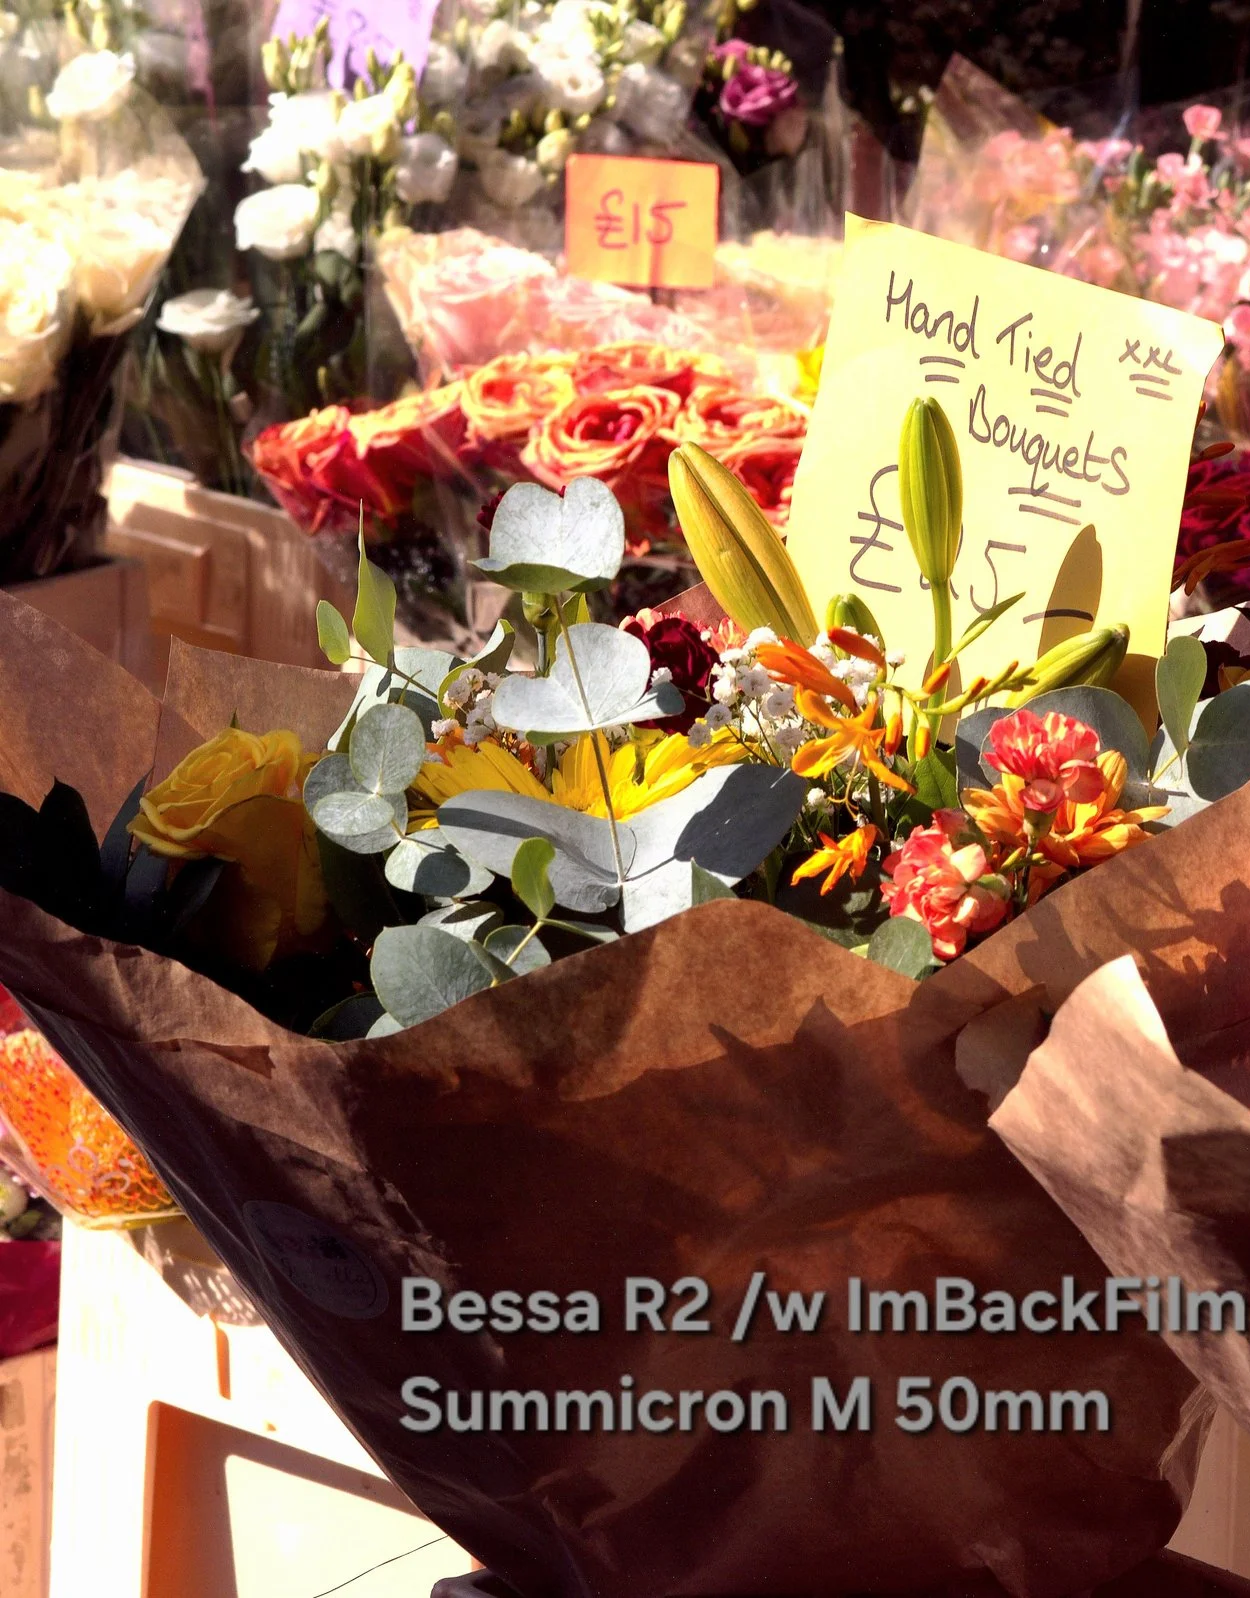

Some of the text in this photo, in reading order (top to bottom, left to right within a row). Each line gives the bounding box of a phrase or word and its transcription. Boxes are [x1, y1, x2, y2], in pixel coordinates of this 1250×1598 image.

[594, 188, 687, 249] £15
[886, 270, 980, 359] Hand
[996, 312, 1081, 398] Tied
[968, 384, 1130, 496] Bouquets
